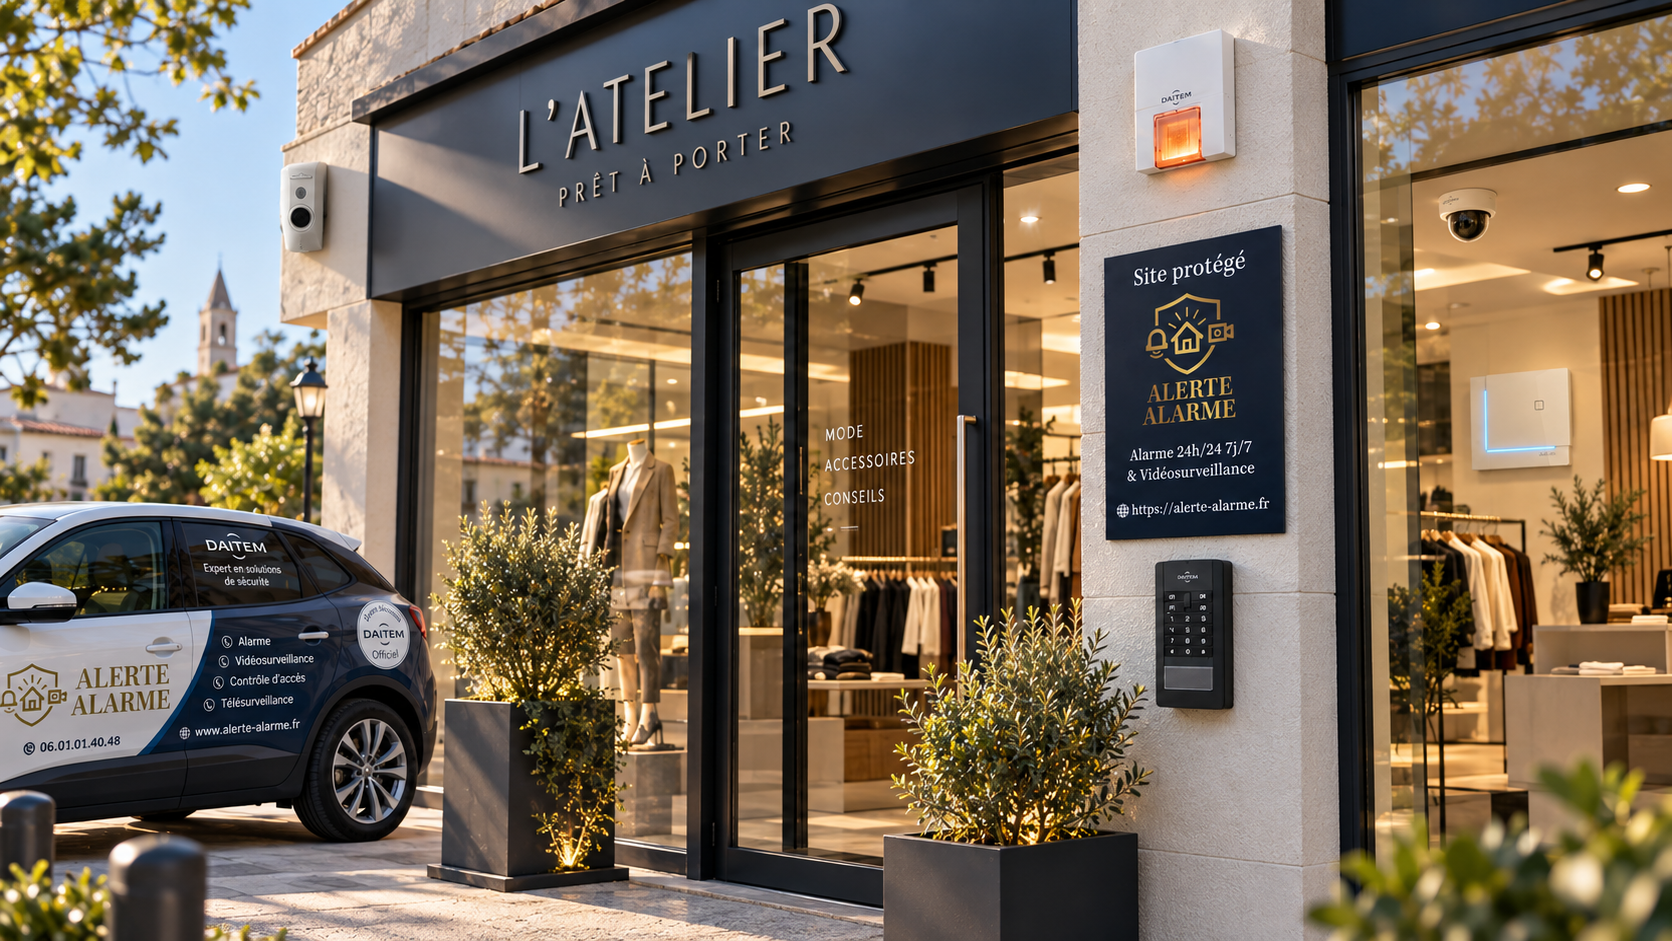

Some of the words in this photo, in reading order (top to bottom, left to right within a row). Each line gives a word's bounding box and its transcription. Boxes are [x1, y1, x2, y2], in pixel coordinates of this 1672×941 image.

[518, 2, 849, 175] L'ATELIER
[1161, 91, 1192, 104] DAITEM
[558, 170, 621, 208] PRÊT
[639, 158, 653, 186] À
[673, 121, 794, 176] PORTER
[1133, 264, 1167, 287] Site
[1172, 250, 1246, 286] protégé
[1147, 376, 1234, 404] ALERTE
[1142, 399, 1237, 426] ALARME
[825, 424, 864, 442] MODE
[1129, 446, 1174, 462] Alarme
[1177, 442, 1222, 460] 24h/24
[1225, 439, 1253, 458] 7j/7
[824, 450, 916, 473] ACCESSOIRES
[1126, 469, 1137, 483] &
[1139, 462, 1256, 482] Vidéosurveillance
[824, 488, 886, 506] CONSEILS
[1131, 496, 1271, 518] https://alerte-alarme.fr
[205, 539, 268, 554] DAITEM
[203, 563, 232, 575] Expert
[233, 565, 244, 573] en
[245, 564, 282, 575] solutions
[224, 576, 235, 586] de
[238, 636, 272, 647] Alarme
[363, 629, 405, 639] DAITEM
[235, 653, 315, 666] Vidéosurveillance
[372, 649, 400, 660] Officiel
[75, 663, 170, 690] ALERTE
[229, 674, 270, 687] Contrôle
[70, 689, 171, 717] ALARME
[221, 694, 294, 709] Télésurveillance
[194, 718, 301, 737] www.alerte-alarme.fr
[39, 735, 121, 753] 06.01.01.40.48
